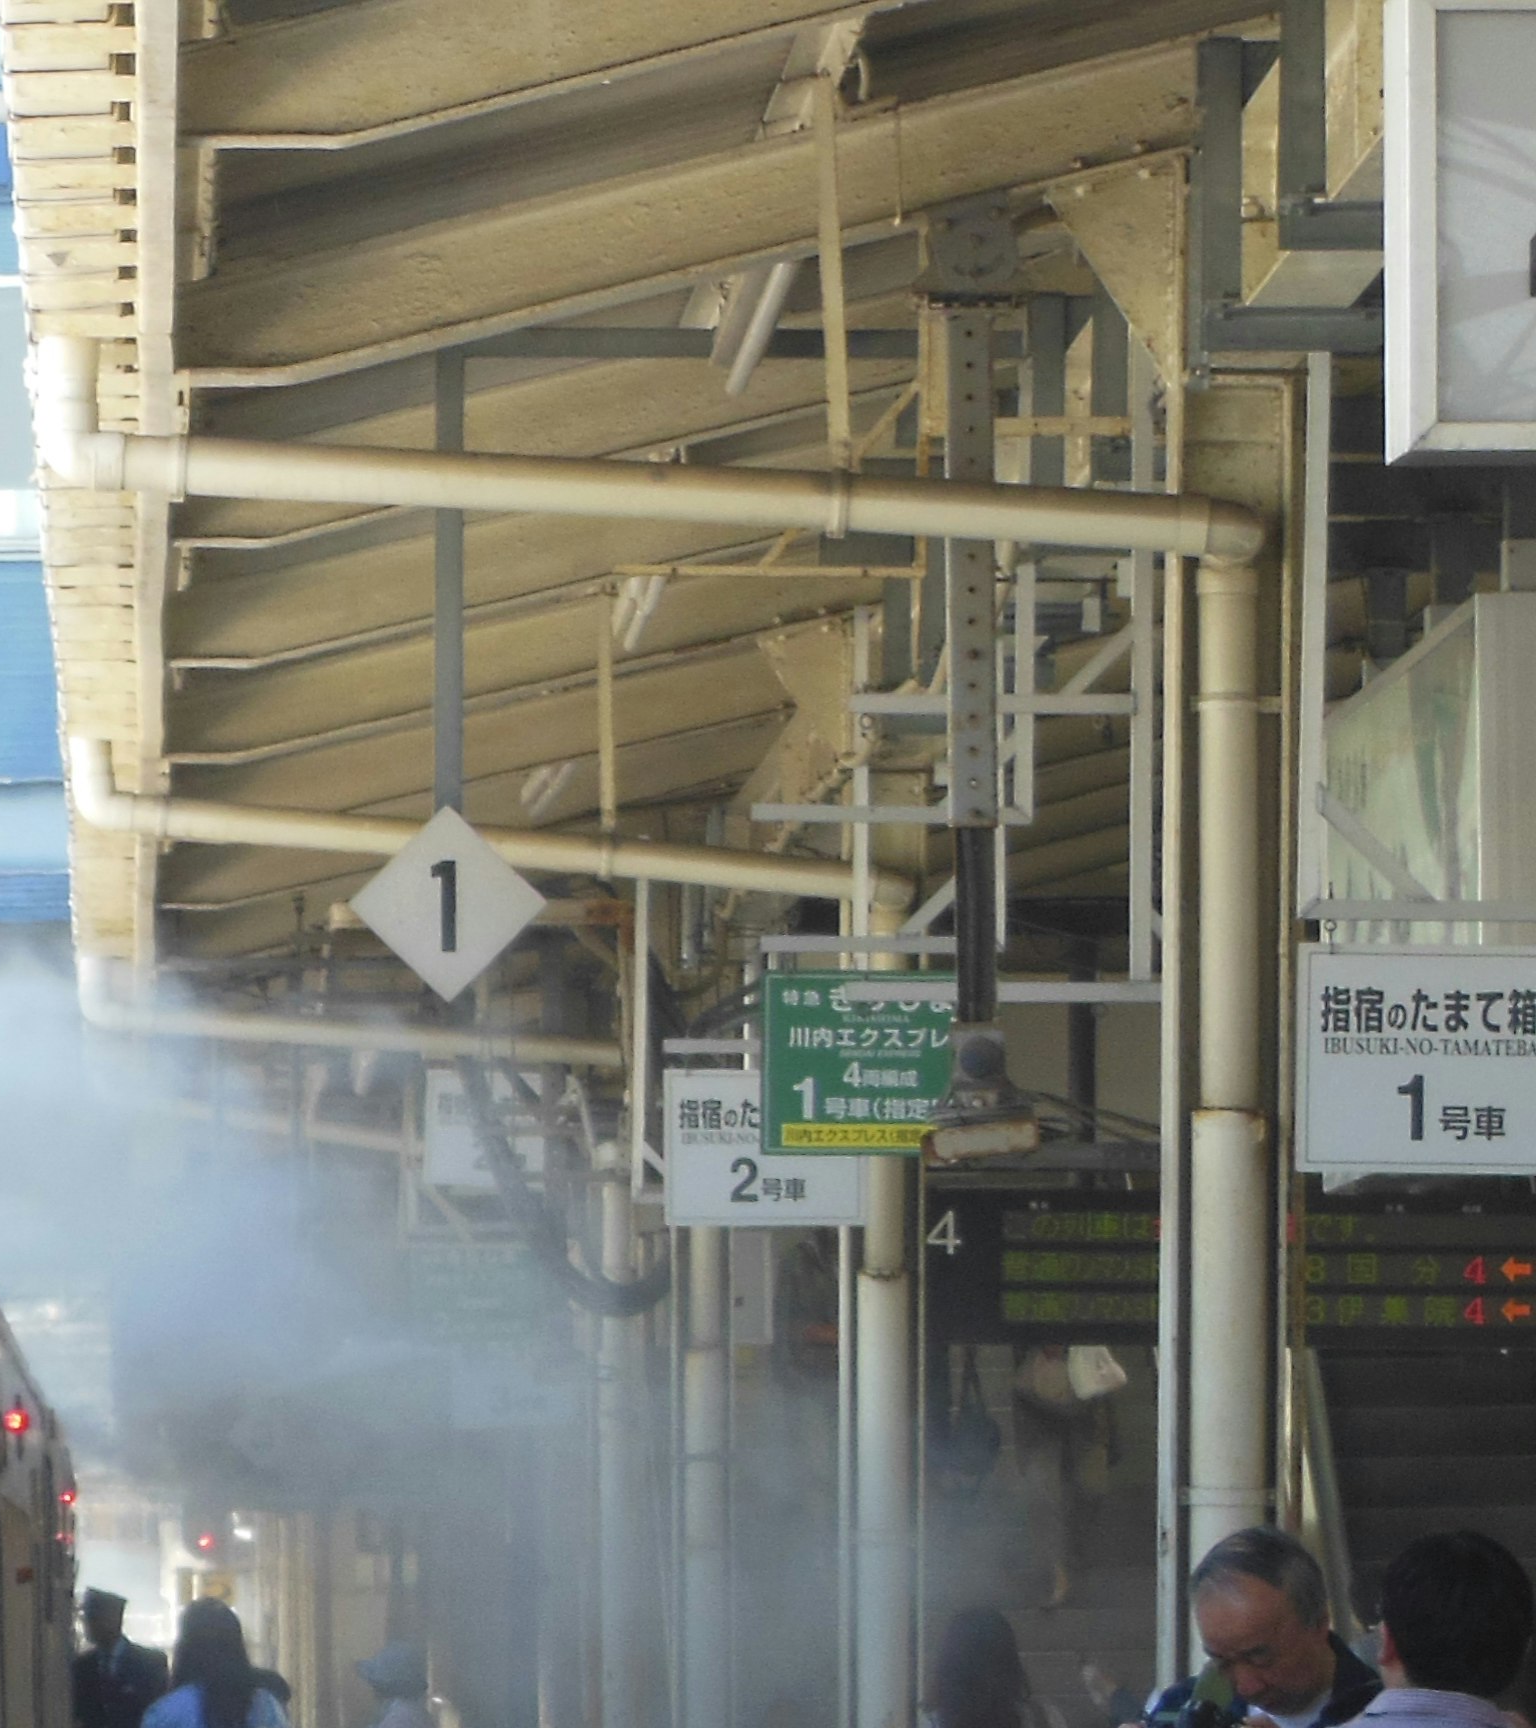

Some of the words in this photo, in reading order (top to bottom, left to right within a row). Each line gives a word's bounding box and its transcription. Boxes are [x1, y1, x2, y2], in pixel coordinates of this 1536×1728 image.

[431, 860, 457, 952] 1
[1321, 985, 1536, 1035] 指宿のたまて箱
[789, 1026, 949, 1048] 川内エクスプレ
[679, 1098, 760, 1129] 指宿のた
[1397, 1074, 1506, 1141] 1号車
[730, 1157, 806, 1202] 2号車
[928, 1210, 961, 1254] 4
[1463, 1256, 1488, 1285] 4
[1463, 1297, 1486, 1325] 4
